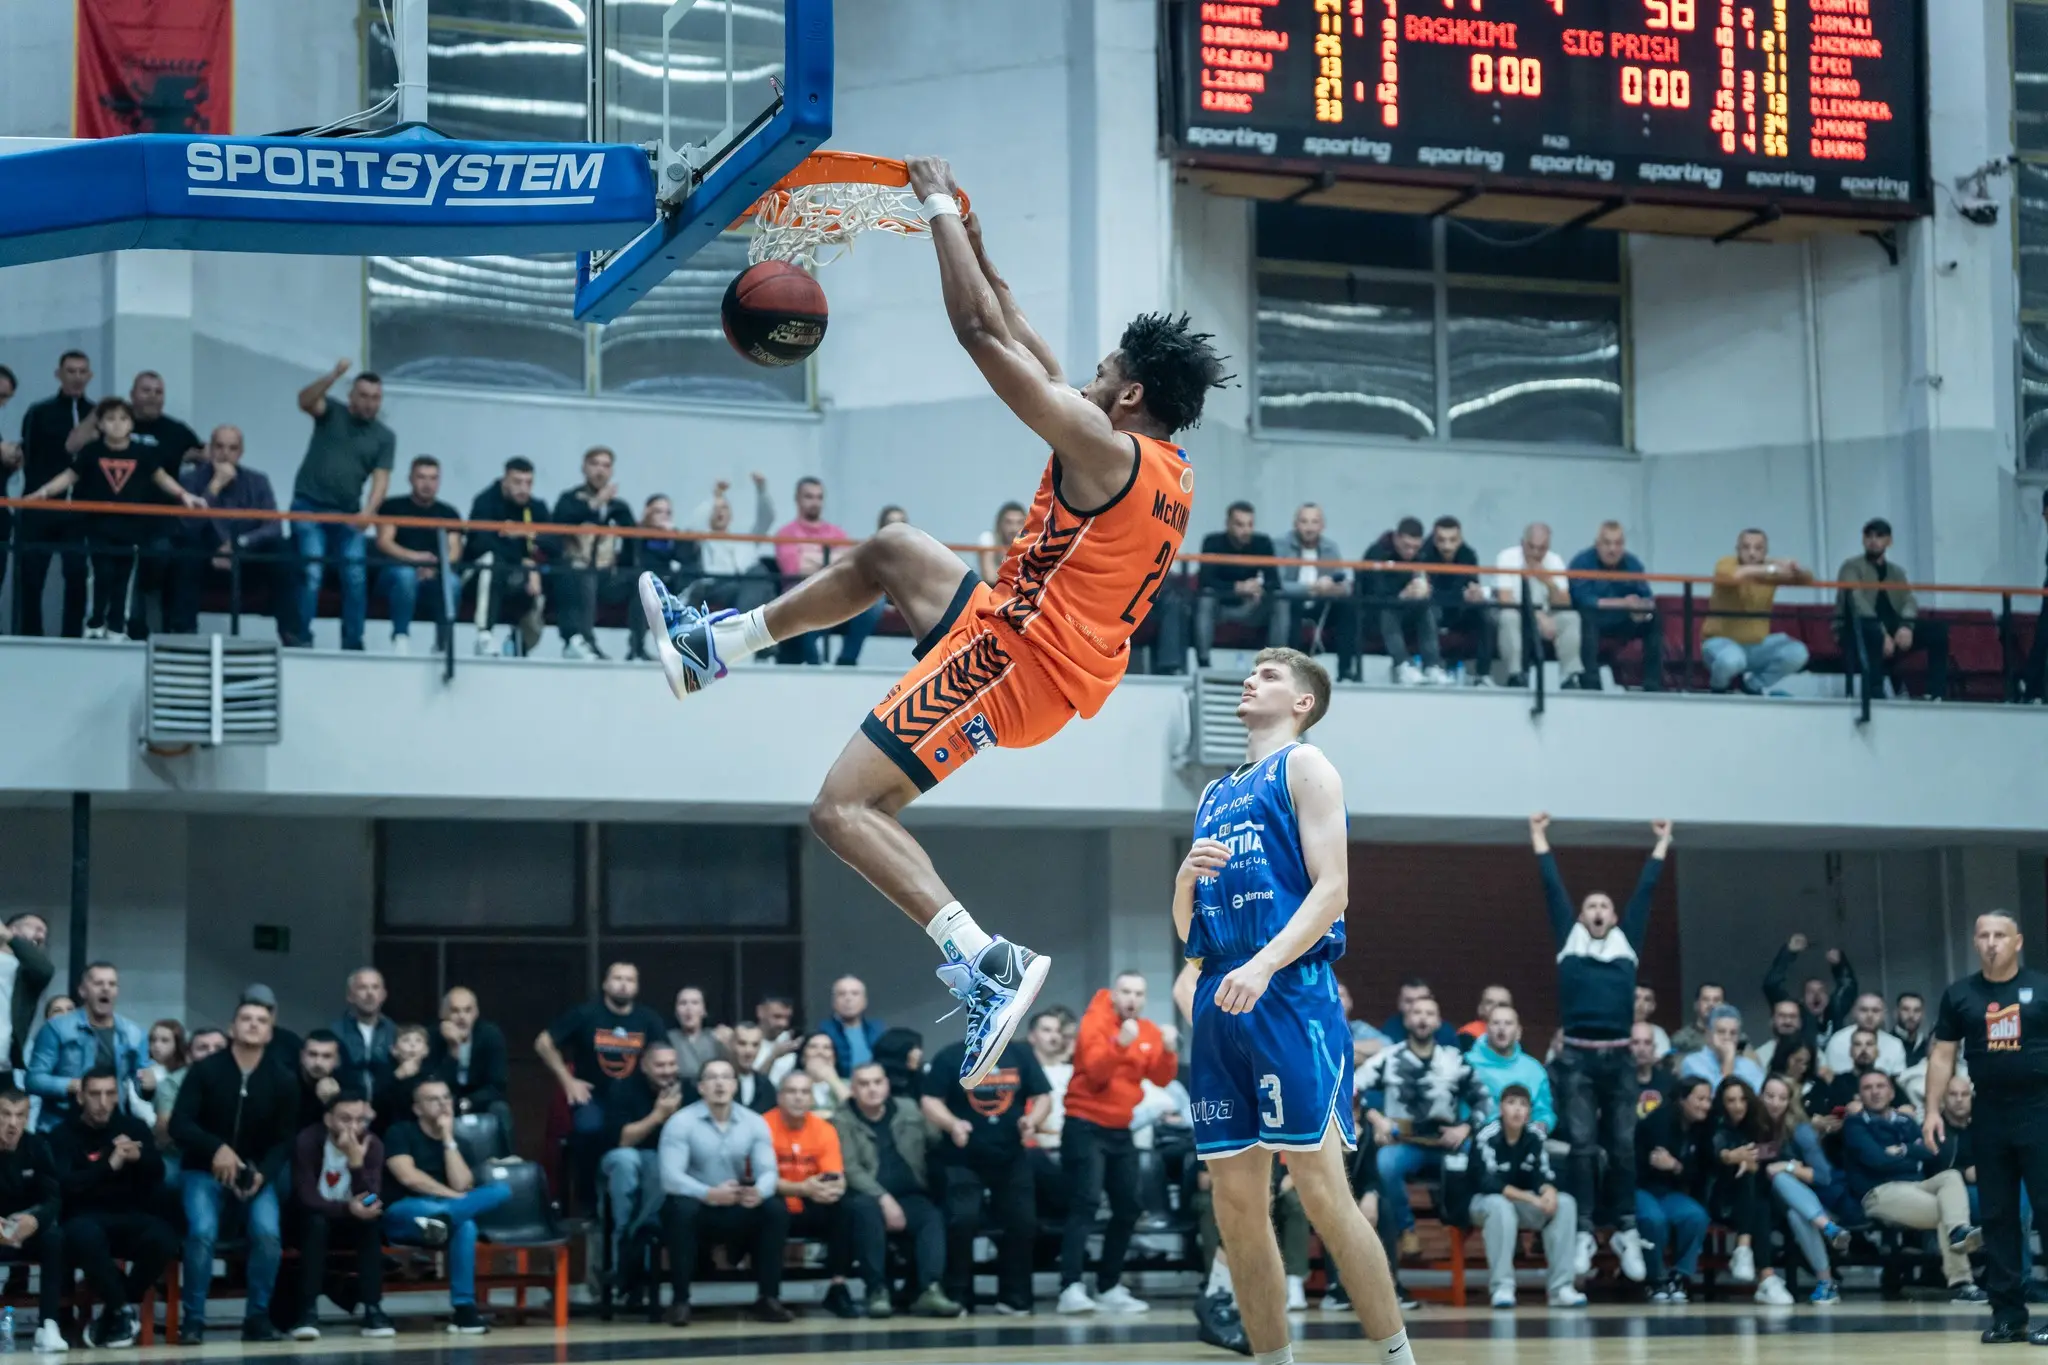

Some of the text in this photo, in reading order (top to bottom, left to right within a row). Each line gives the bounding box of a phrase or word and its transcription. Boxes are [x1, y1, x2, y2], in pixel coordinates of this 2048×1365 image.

[1321, 13, 1341, 35] 11
[1354, 16, 1363, 37] 1
[1404, 14, 1518, 49] BASHKIMI
[1740, 7, 1754, 29] 2
[1774, 10, 1786, 31] 3
[1562, 29, 1680, 63] SIG PRISH
[1713, 26, 1734, 48] 10
[1747, 29, 1755, 50] 1
[1762, 30, 1787, 52] 21
[1321, 56, 1341, 78] 13
[1721, 47, 1734, 69] 0
[1315, 77, 1341, 99] 27
[1354, 81, 1364, 102] 1
[1376, 82, 1397, 104] 12
[1721, 68, 1734, 90] 0
[1741, 70, 1755, 91] 3
[1762, 72, 1787, 94] 31
[1316, 98, 1342, 122] 33
[1715, 89, 1735, 111] 15
[1741, 91, 1755, 112] 2
[1768, 93, 1787, 115] 13
[1710, 109, 1735, 131] 20
[1747, 112, 1755, 133] 1
[1764, 113, 1787, 134] 34
[1187, 127, 1277, 153] sporting
[1304, 137, 1391, 162] sporting
[1741, 132, 1756, 155] 4
[1764, 134, 1788, 157] 55
[1418, 146, 1504, 171] sporting
[1530, 154, 1614, 180] sporting
[1639, 161, 1722, 189] sporting
[1747, 170, 1815, 193] sporting
[1841, 176, 1909, 203] sporting
[1230, 856, 1269, 870] MERCUR
[1990, 1014, 2018, 1040] albi
[1988, 1039, 2021, 1052] MALL
[1191, 1097, 1234, 1125] vipa
[1260, 1074, 1285, 1128] 3
